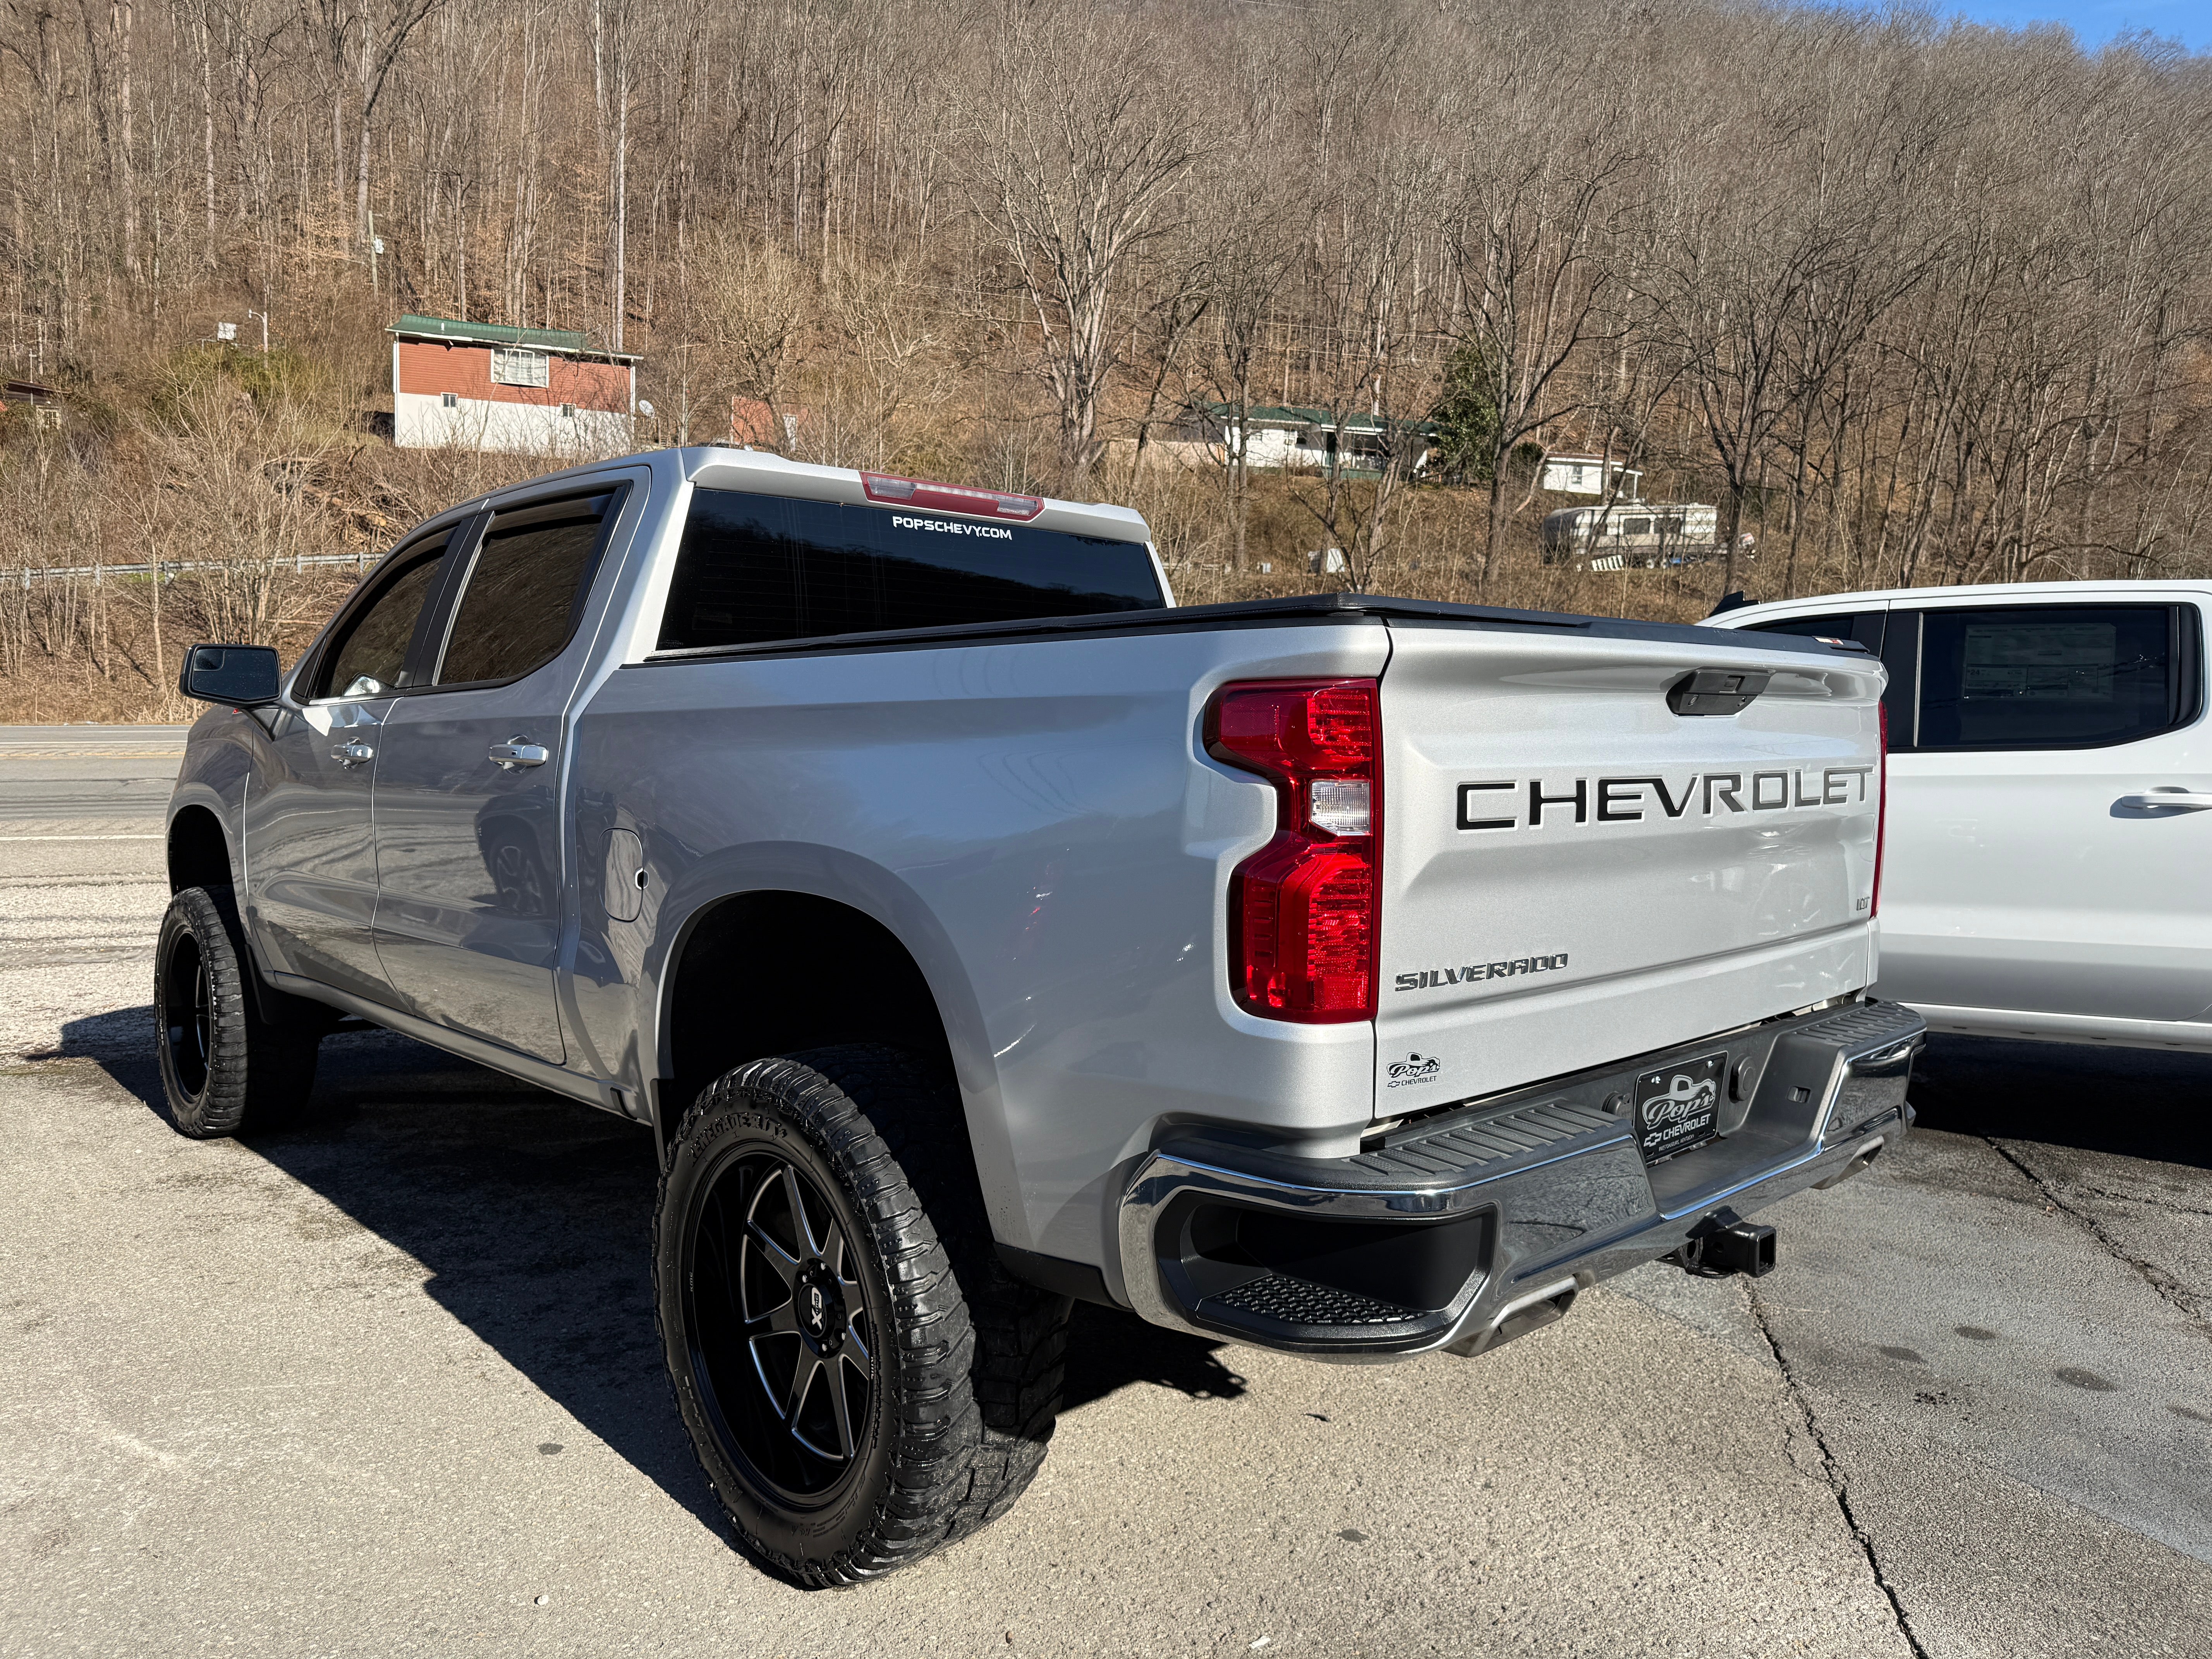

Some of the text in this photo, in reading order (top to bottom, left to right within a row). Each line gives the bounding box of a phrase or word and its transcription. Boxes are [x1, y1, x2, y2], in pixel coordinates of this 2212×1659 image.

[892, 516, 1012, 540] POPSCHEVY.COM
[1456, 764, 1874, 830] CHEVROLET
[1395, 953, 1568, 991] SILVERADO
[1401, 1076, 1437, 1086] CHEVROLET
[1663, 1113, 1711, 1140] CHEVROLET
[812, 1287, 822, 1330] XD
